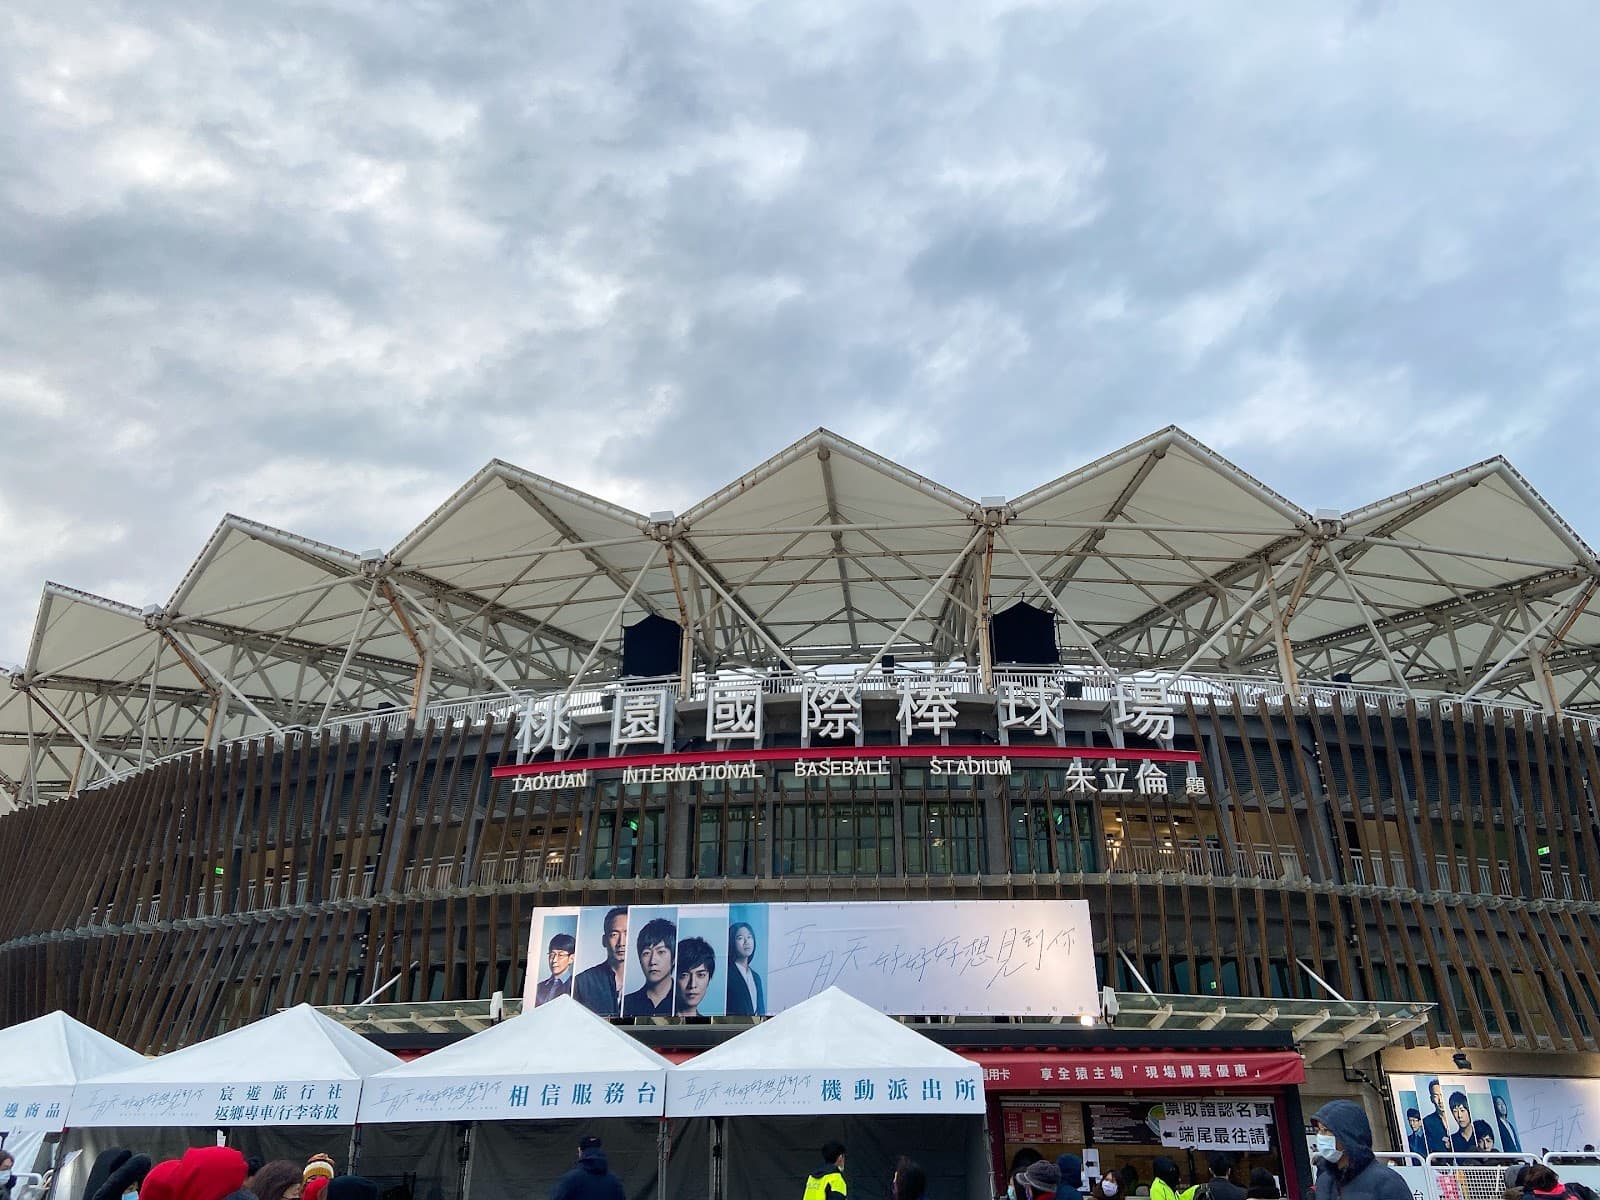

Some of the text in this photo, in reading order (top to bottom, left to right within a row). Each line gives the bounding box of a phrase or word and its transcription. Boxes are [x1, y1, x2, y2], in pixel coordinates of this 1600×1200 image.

[514, 677, 1175, 754] 桃園國際棒球場
[511, 759, 1012, 793] TAOYUAN INTERNATIONAL BASEBALL STADIUM
[1066, 763, 1168, 795] 朱立倫
[508, 1081, 657, 1107] 相信服務台
[821, 1078, 976, 1102] 機動派出所
[215, 1103, 340, 1121] 返鄉專車/行李寄放
